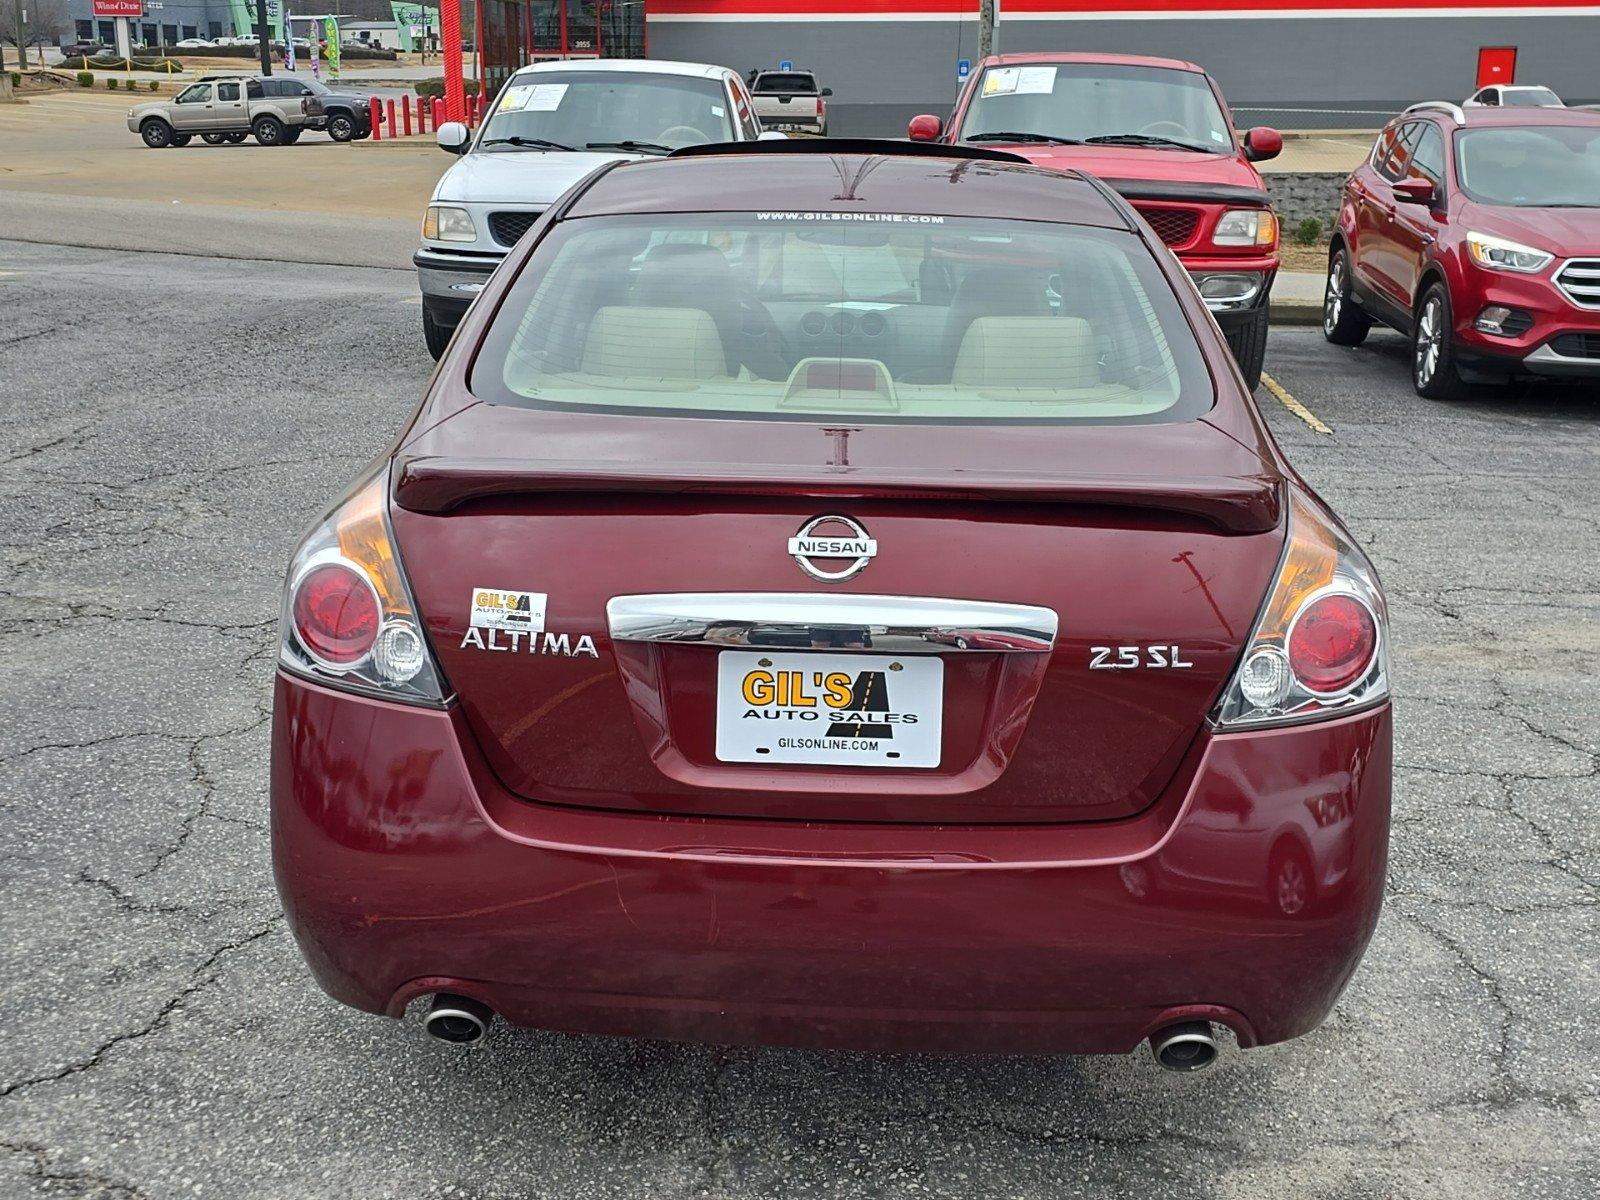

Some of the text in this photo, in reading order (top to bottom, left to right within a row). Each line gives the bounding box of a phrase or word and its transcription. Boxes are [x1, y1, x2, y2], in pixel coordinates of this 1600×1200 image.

[756, 212, 944, 224] WWW.GILSONLINE.COM
[798, 541, 867, 553] NISSAN
[476, 591, 519, 610] GIL'S
[460, 626, 599, 659] ALTIMA
[1146, 645, 1193, 669] SL
[742, 669, 853, 710] GIL'S
[742, 709, 919, 724] AUTO SALES
[778, 737, 879, 751] GILSONLINE.COM
